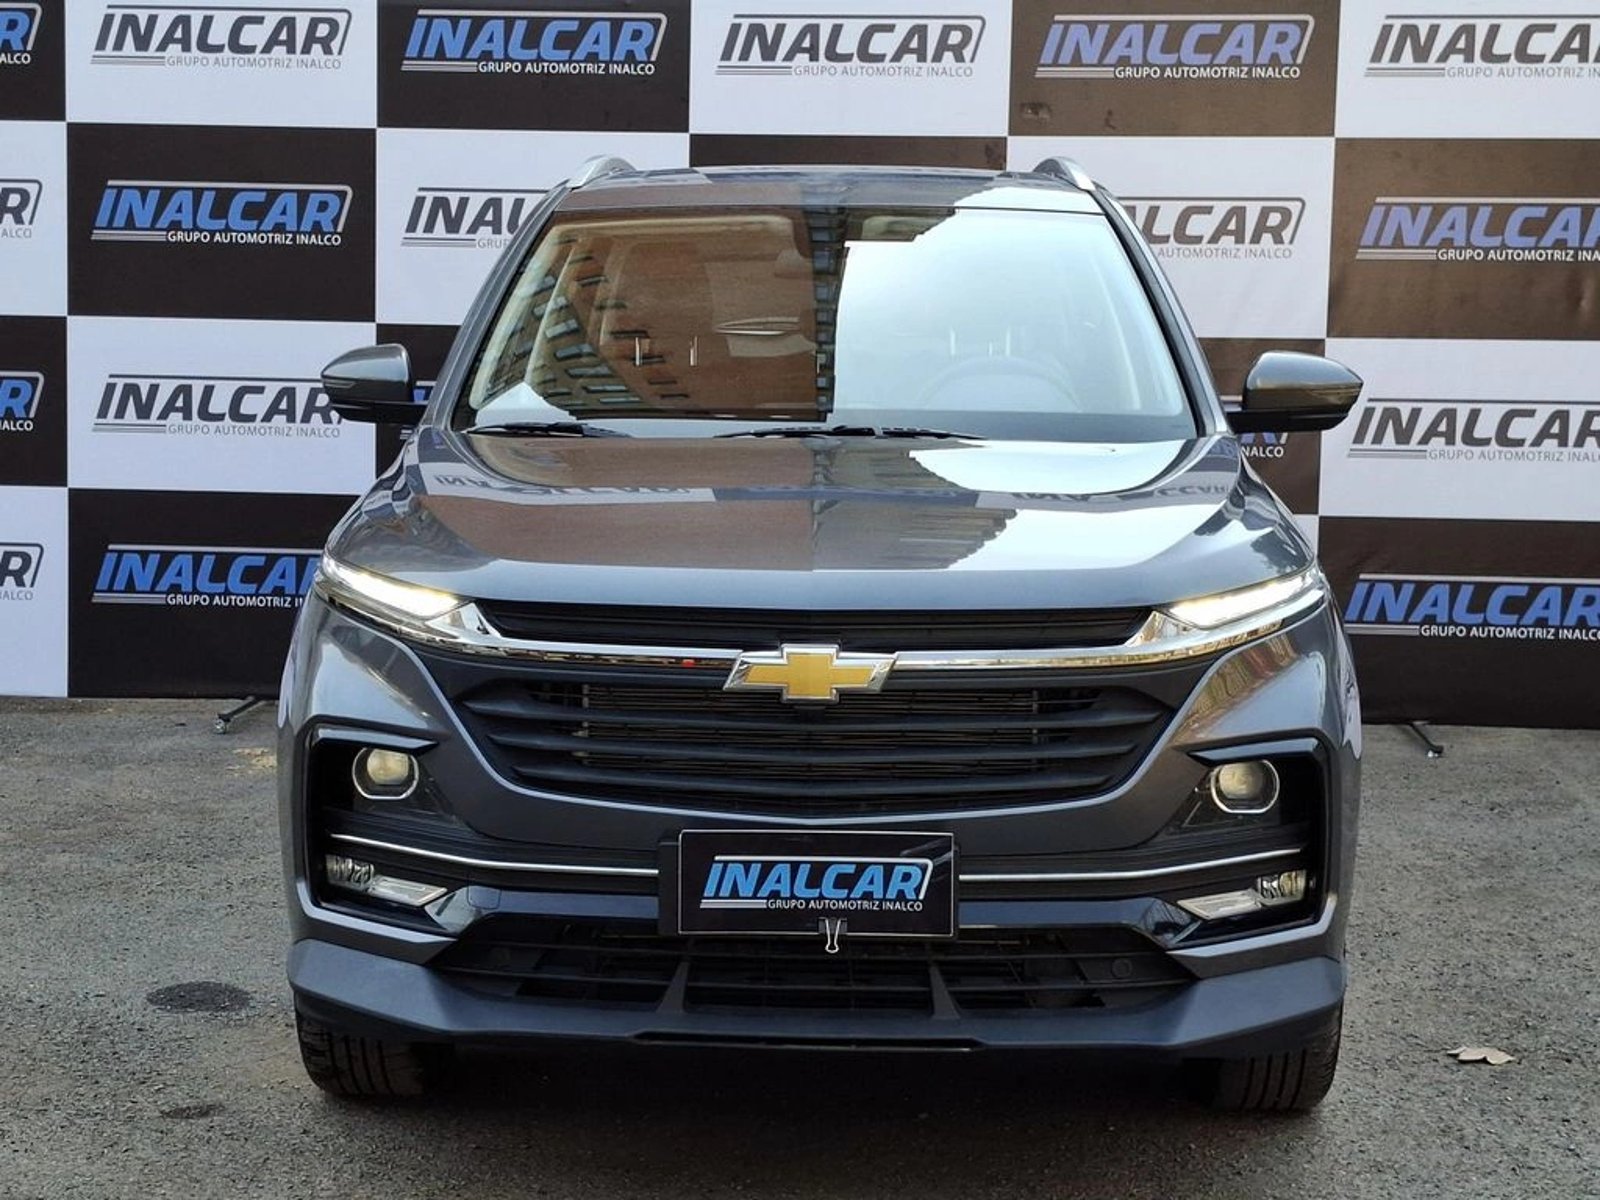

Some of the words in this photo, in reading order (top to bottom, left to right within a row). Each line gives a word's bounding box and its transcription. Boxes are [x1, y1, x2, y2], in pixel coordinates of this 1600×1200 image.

[95, 14, 341, 55] INALCAR
[404, 18, 656, 61] INALCAR
[719, 23, 973, 63] INALCAR
[1040, 24, 1301, 65] INALCAR
[1369, 24, 1600, 64] INALCA
[0, 54, 31, 65] ALCO
[166, 56, 210, 67] GRUPO
[213, 57, 292, 69] AUTOMOTRIZ
[296, 59, 341, 70] INALCO
[478, 61, 522, 73] GRUPO
[524, 63, 606, 74] AUTOMOTRIZ
[608, 64, 656, 75] INALCO
[793, 65, 837, 76] GRUPO
[841, 66, 923, 77] AUTOMOTRIZ
[926, 66, 973, 77] INALCO
[1115, 67, 1160, 78] GRUPO
[1164, 67, 1248, 78] AUTOMOTRIZ
[1252, 67, 1301, 78] INALCO
[1447, 67, 1493, 79] GRUPO
[1498, 67, 1583, 78] AUTOMOTRIZ
[95, 188, 342, 232] INALCAR
[405, 195, 526, 235] INAL
[1123, 205, 1293, 245] LCAR
[2, 228, 32, 239] ALCO
[167, 230, 210, 243] GRUPO
[213, 232, 293, 245] AUTOMOTRIZ
[296, 234, 341, 246] INALCO
[477, 238, 511, 249] GRUP
[1244, 248, 1293, 259] INALCO
[1438, 250, 1484, 261] GRUPO
[1487, 250, 1574, 261] AUTOMOTRIZ
[1578, 250, 1600, 261] INA
[96, 382, 334, 424] INALCAR
[0, 420, 33, 432] ALCO
[167, 424, 210, 435] GRUPO
[214, 425, 292, 437] AUTOMOTRIZ
[296, 427, 340, 438] INALCO
[1241, 446, 1284, 458] NALCO
[1429, 449, 1474, 460] GRUPO
[1478, 450, 1564, 462] AUTOMOTRIZ
[1568, 452, 1600, 463] INAL
[0, 588, 33, 600] ALCO
[166, 593, 210, 606] GRUPO
[214, 595, 291, 608] AUTOMOTRIZ
[1345, 582, 1600, 626] INALCAR
[1421, 624, 1466, 636] GRUPO
[1470, 626, 1555, 639] AUTOMOTRIZ
[703, 863, 922, 899] INALCAR
[768, 899, 806, 910] GRUPO
[808, 900, 879, 911] AUTOMOTRIZ
[882, 902, 923, 912] INALCO
